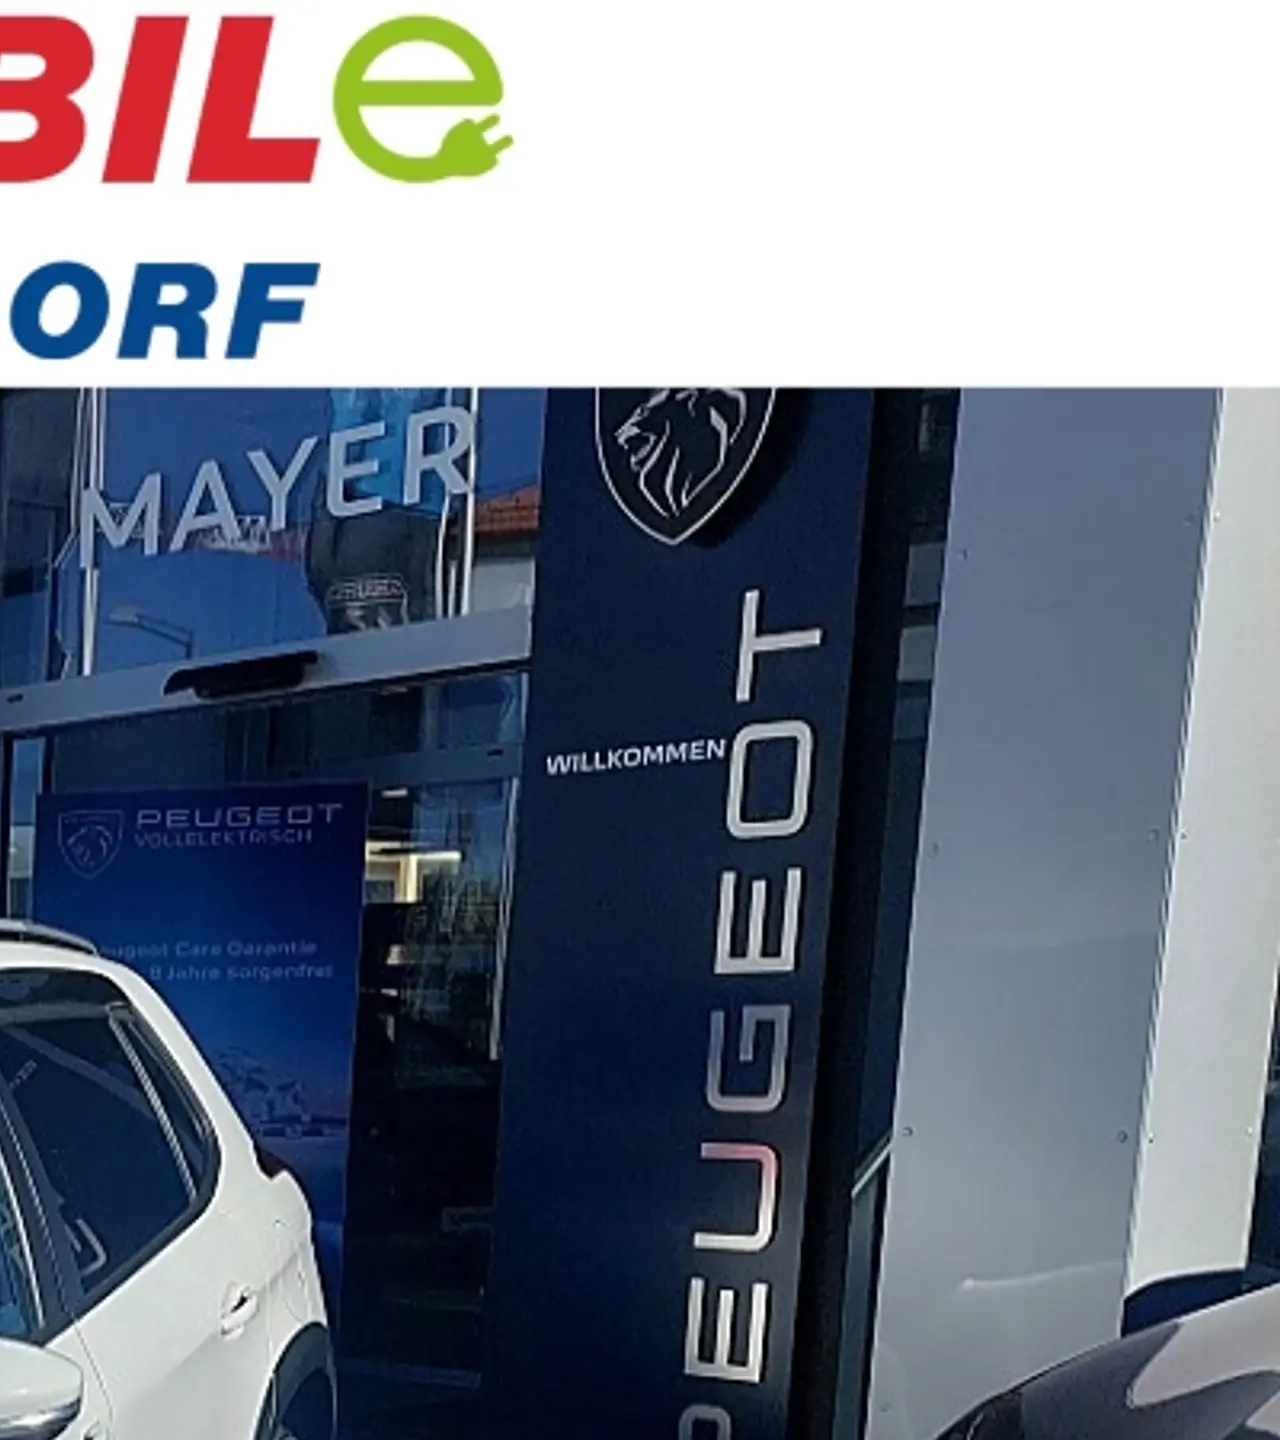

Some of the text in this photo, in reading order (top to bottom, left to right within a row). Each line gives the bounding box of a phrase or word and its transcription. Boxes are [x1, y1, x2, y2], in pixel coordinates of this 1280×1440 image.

[80, 405, 475, 569] MAYER
[545, 738, 727, 776] WILLKOMMEN
[136, 803, 343, 828] PEUGEOT
[175, 940, 222, 958] Care
[227, 939, 318, 958] Garantie
[166, 965, 222, 982] Jahre
[227, 963, 334, 982] sorgenfrei
